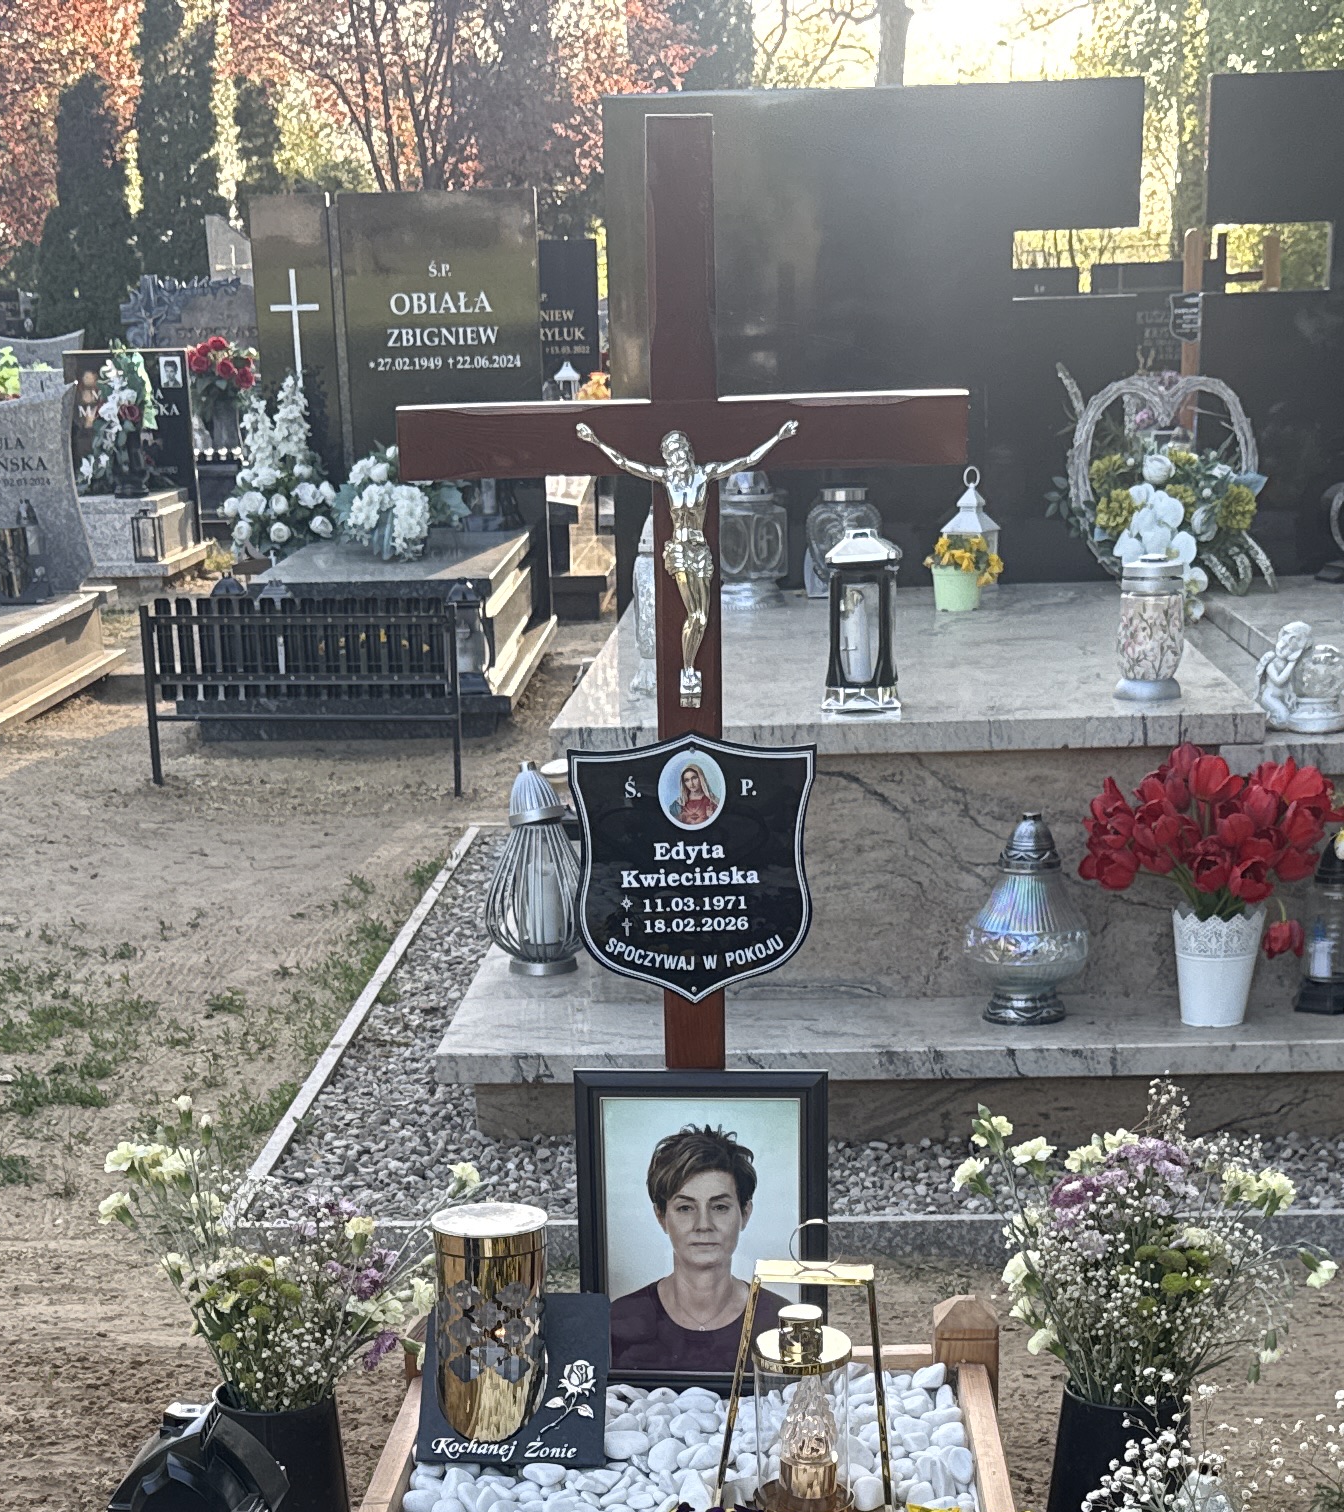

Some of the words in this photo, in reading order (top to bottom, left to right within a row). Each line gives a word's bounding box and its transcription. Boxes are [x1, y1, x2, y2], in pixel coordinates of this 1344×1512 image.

[390, 290, 493, 315] OBIAŁA
[540, 309, 574, 321] NIEW
[387, 326, 499, 347] ZBIGNIEW
[377, 357, 442, 371] 27.02.1949
[456, 354, 521, 369] 22.06.2024
[624, 776, 642, 798] Ś.
[740, 778, 757, 796] P.
[653, 841, 725, 864] Edyta
[620, 866, 760, 888] Kwiecińska
[643, 896, 748, 912] 11.03.1971
[644, 917, 749, 933] 18.02.2026
[605, 937, 695, 971] SPOCZYWAJ
[703, 955, 717, 970] W
[724, 934, 784, 968] POKOJU
[431, 1437, 518, 1462] Kochanej
[524, 1434, 577, 1459] Żonie
